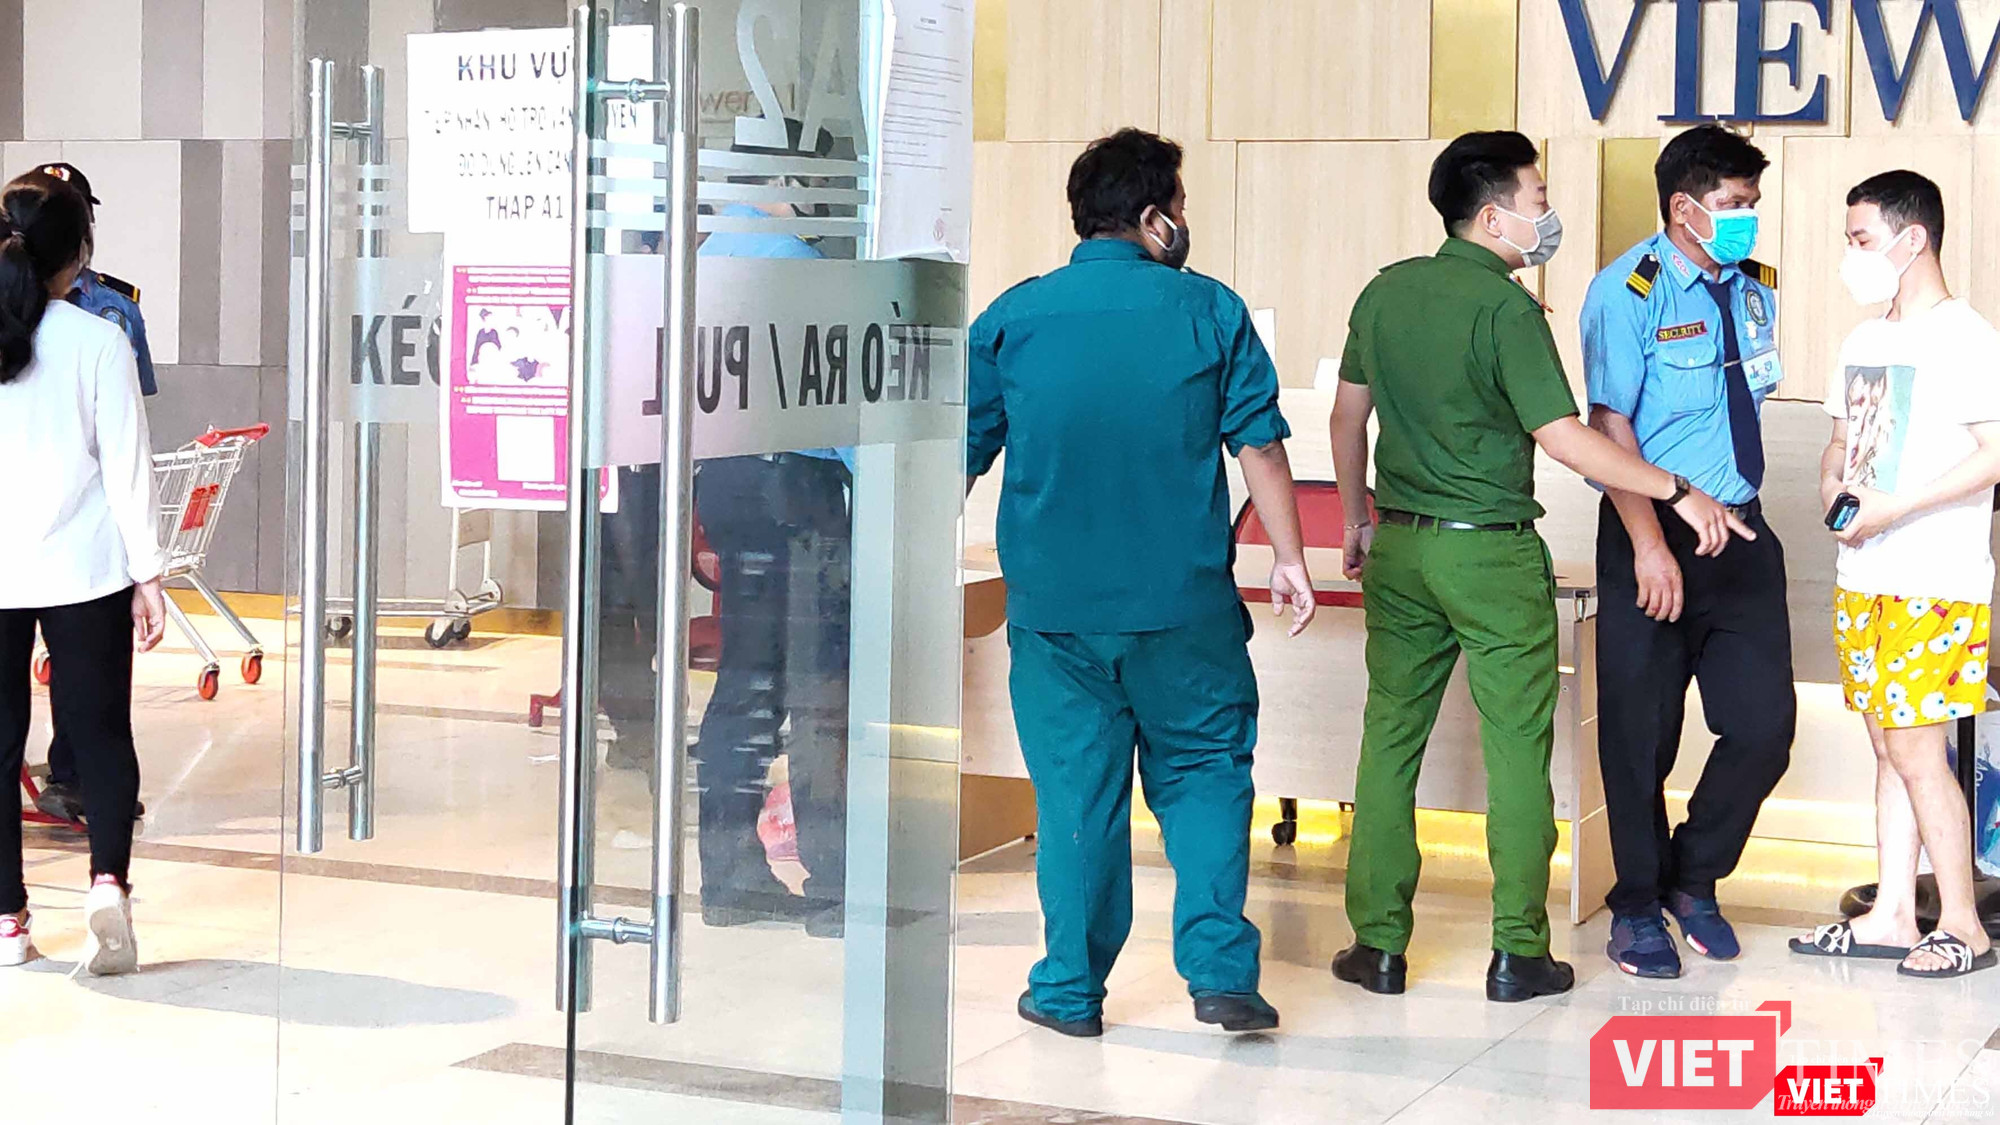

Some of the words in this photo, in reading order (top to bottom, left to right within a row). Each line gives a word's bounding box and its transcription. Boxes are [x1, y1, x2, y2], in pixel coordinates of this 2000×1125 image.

[457, 53, 517, 82] KHU
[529, 44, 573, 85] VỰ
[1556, 0, 2000, 123] VIEW
[1657, 323, 1703, 341] SECURITY
